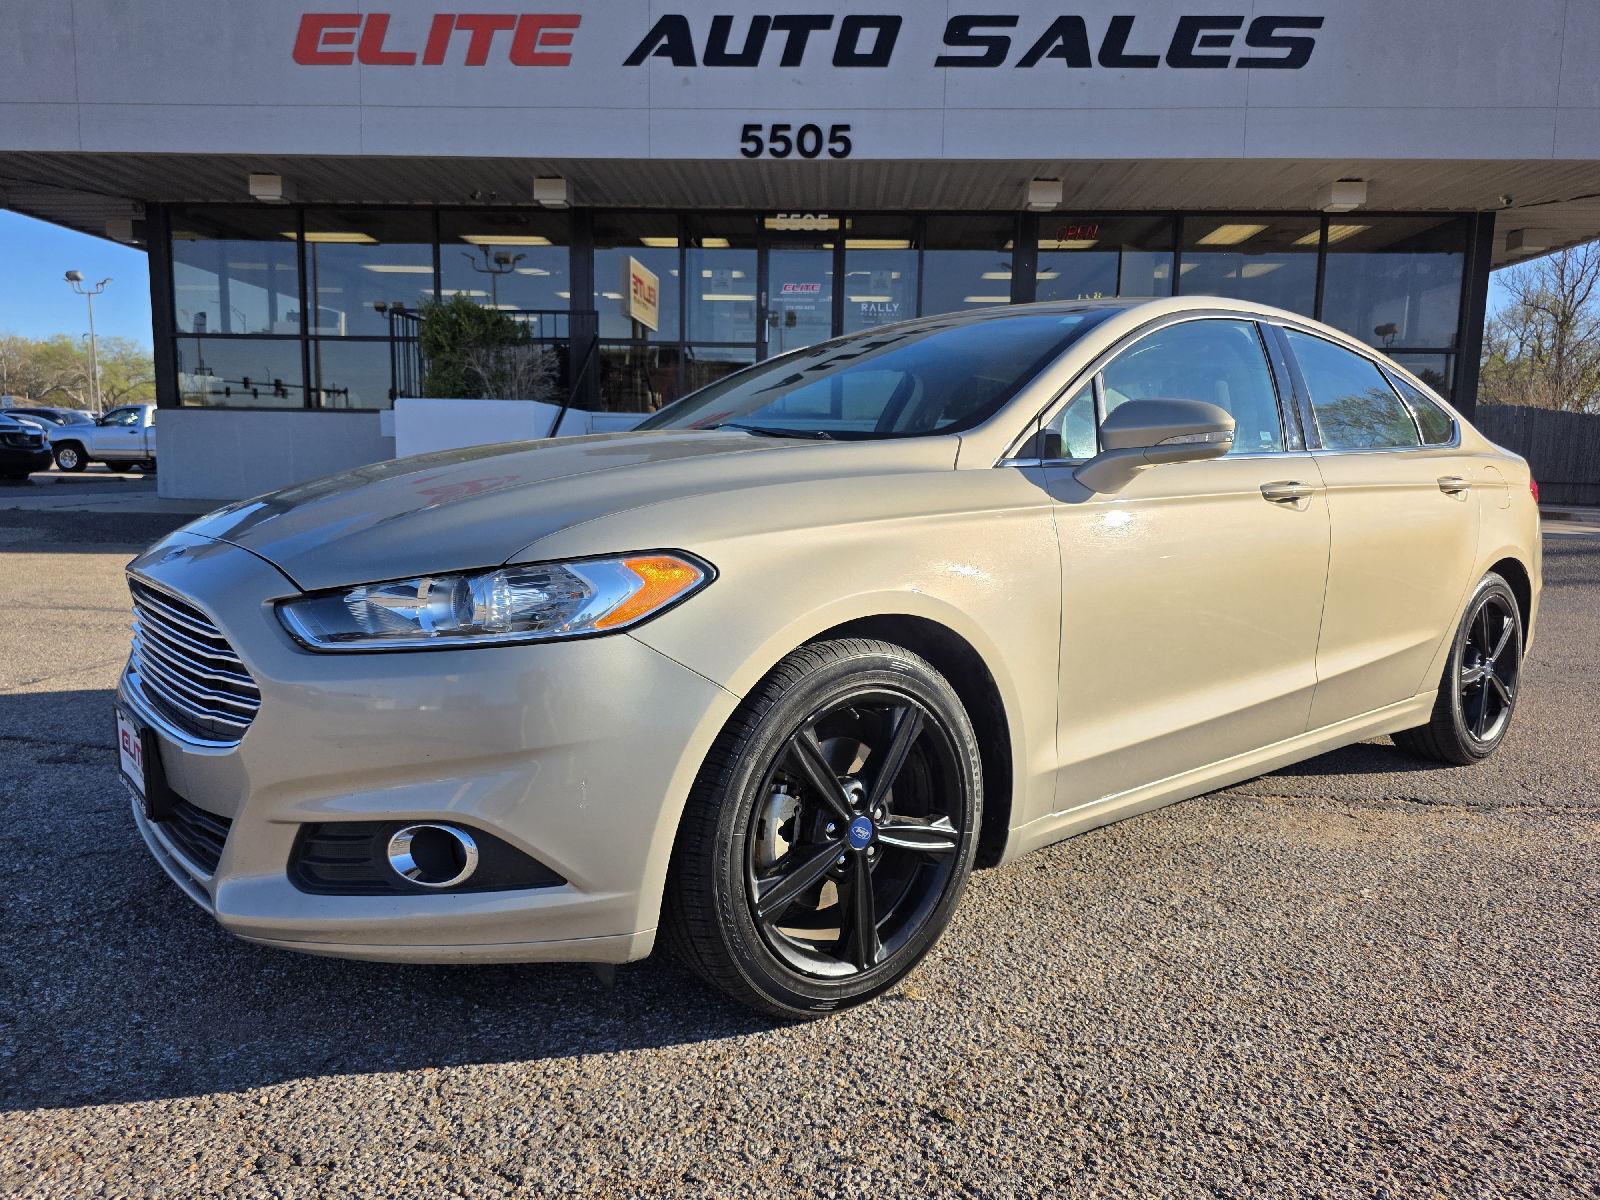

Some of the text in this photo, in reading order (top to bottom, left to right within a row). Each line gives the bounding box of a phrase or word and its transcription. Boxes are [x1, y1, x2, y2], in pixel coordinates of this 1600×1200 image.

[292, 13, 1325, 69] ELITE AUTO SALES
[739, 123, 853, 159] 5505
[776, 213, 829, 231] 5505
[1056, 224, 1099, 242] OPEN
[782, 283, 821, 294] ELITE
[861, 303, 900, 312] RALLY
